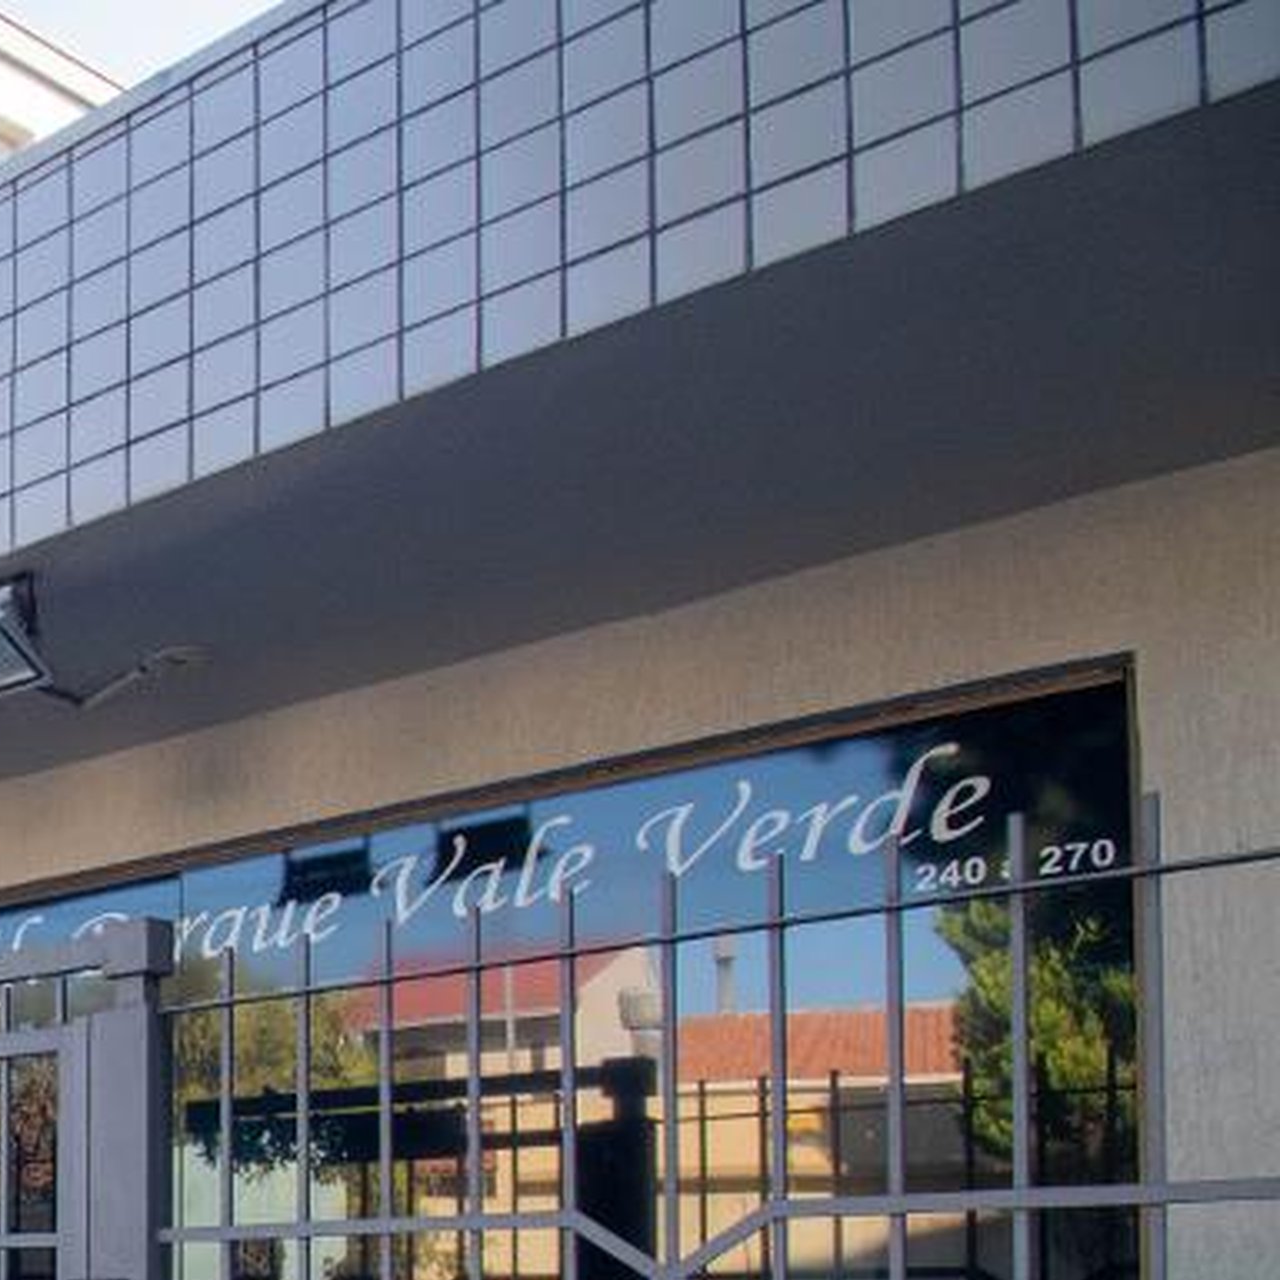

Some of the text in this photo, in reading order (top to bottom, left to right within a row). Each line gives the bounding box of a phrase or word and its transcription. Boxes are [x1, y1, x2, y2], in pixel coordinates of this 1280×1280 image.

[371, 815, 595, 925] Vale
[636, 742, 991, 877] Verde
[915, 855, 987, 892] 240
[1039, 838, 1116, 877] 270
